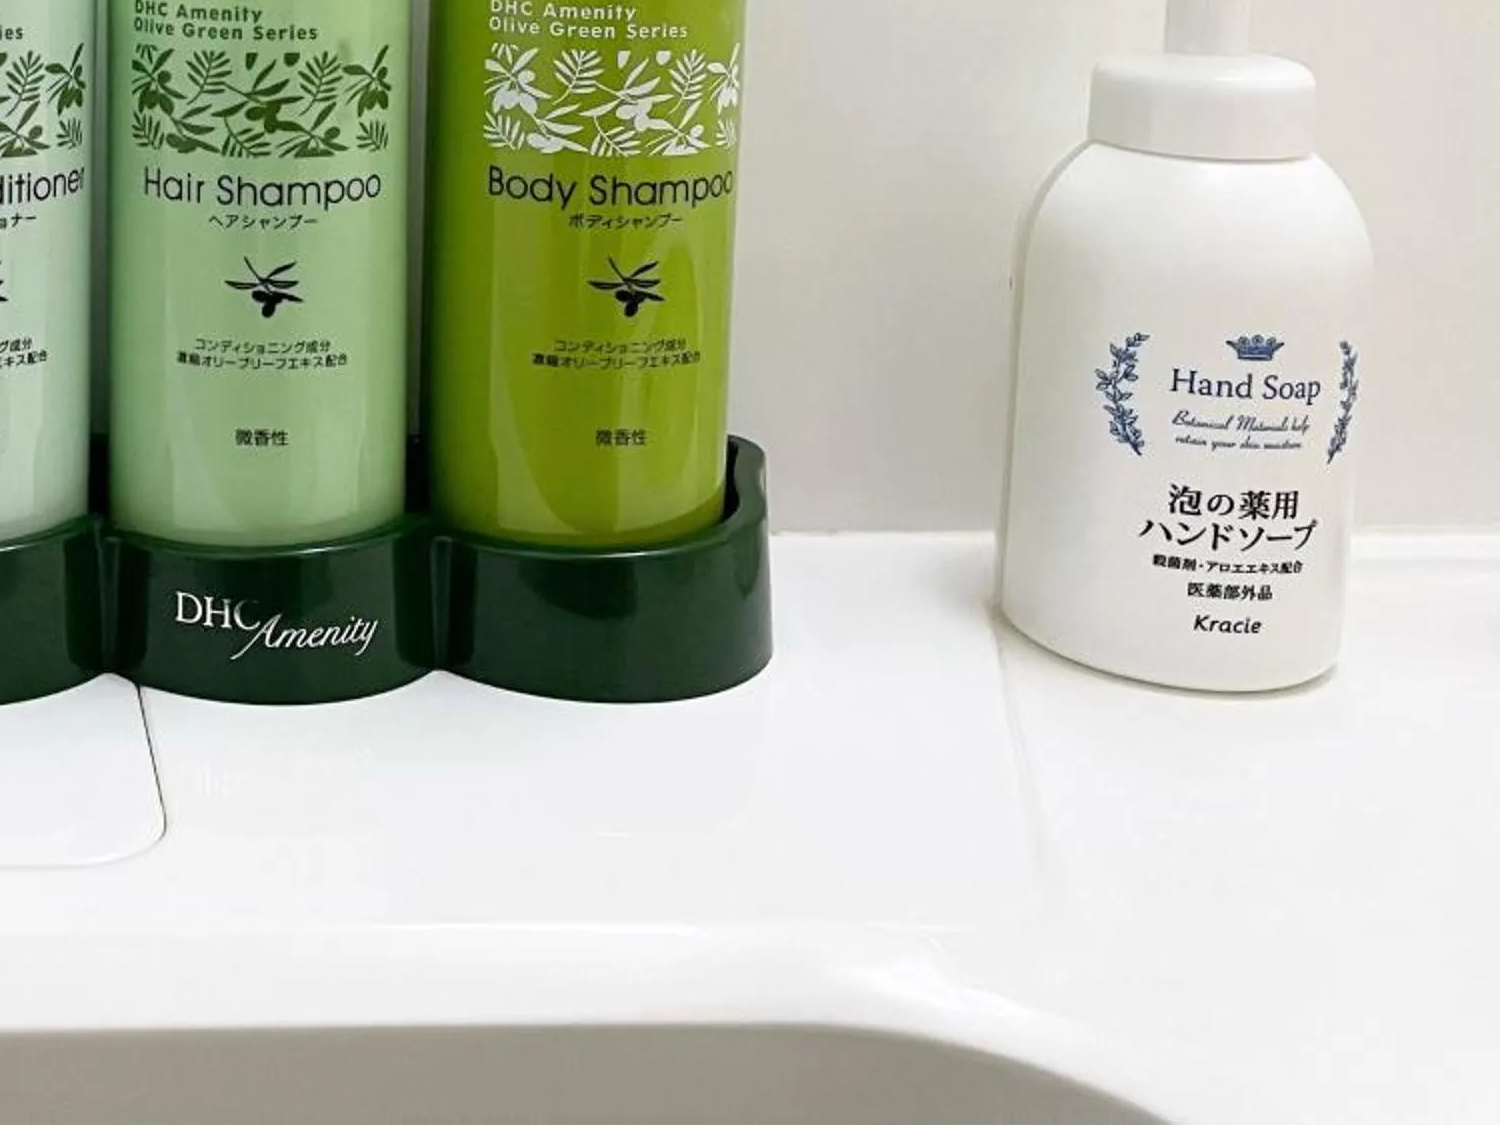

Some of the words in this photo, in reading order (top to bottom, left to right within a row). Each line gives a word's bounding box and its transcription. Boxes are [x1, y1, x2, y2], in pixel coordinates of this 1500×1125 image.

[134, 0, 167, 16] DHC
[176, 4, 262, 24] Amenity
[490, 0, 532, 16] DHC
[543, 2, 636, 21] Amenity
[134, 17, 174, 35] Olive
[183, 23, 243, 40] Green
[253, 25, 318, 40] Series
[489, 17, 540, 34] Olive
[550, 22, 616, 40] Green
[626, 23, 688, 40] Series
[144, 166, 205, 204] Hair
[217, 174, 381, 211] Shampoo
[489, 165, 577, 210] Body
[588, 171, 733, 208] Shampoo
[209, 214, 318, 229] ヘアシャンプー
[569, 213, 683, 229] ボディシャンプー
[1170, 368, 1253, 399] Hand
[1262, 374, 1321, 405] Soap
[1169, 483, 1299, 521] 泡の薬用
[1139, 519, 1318, 552] ハンドソープ
[1188, 582, 1273, 601] 医薬部外品
[175, 591, 260, 630] DHC
[230, 613, 378, 660] Amenity
[1193, 614, 1263, 635] Kracie
